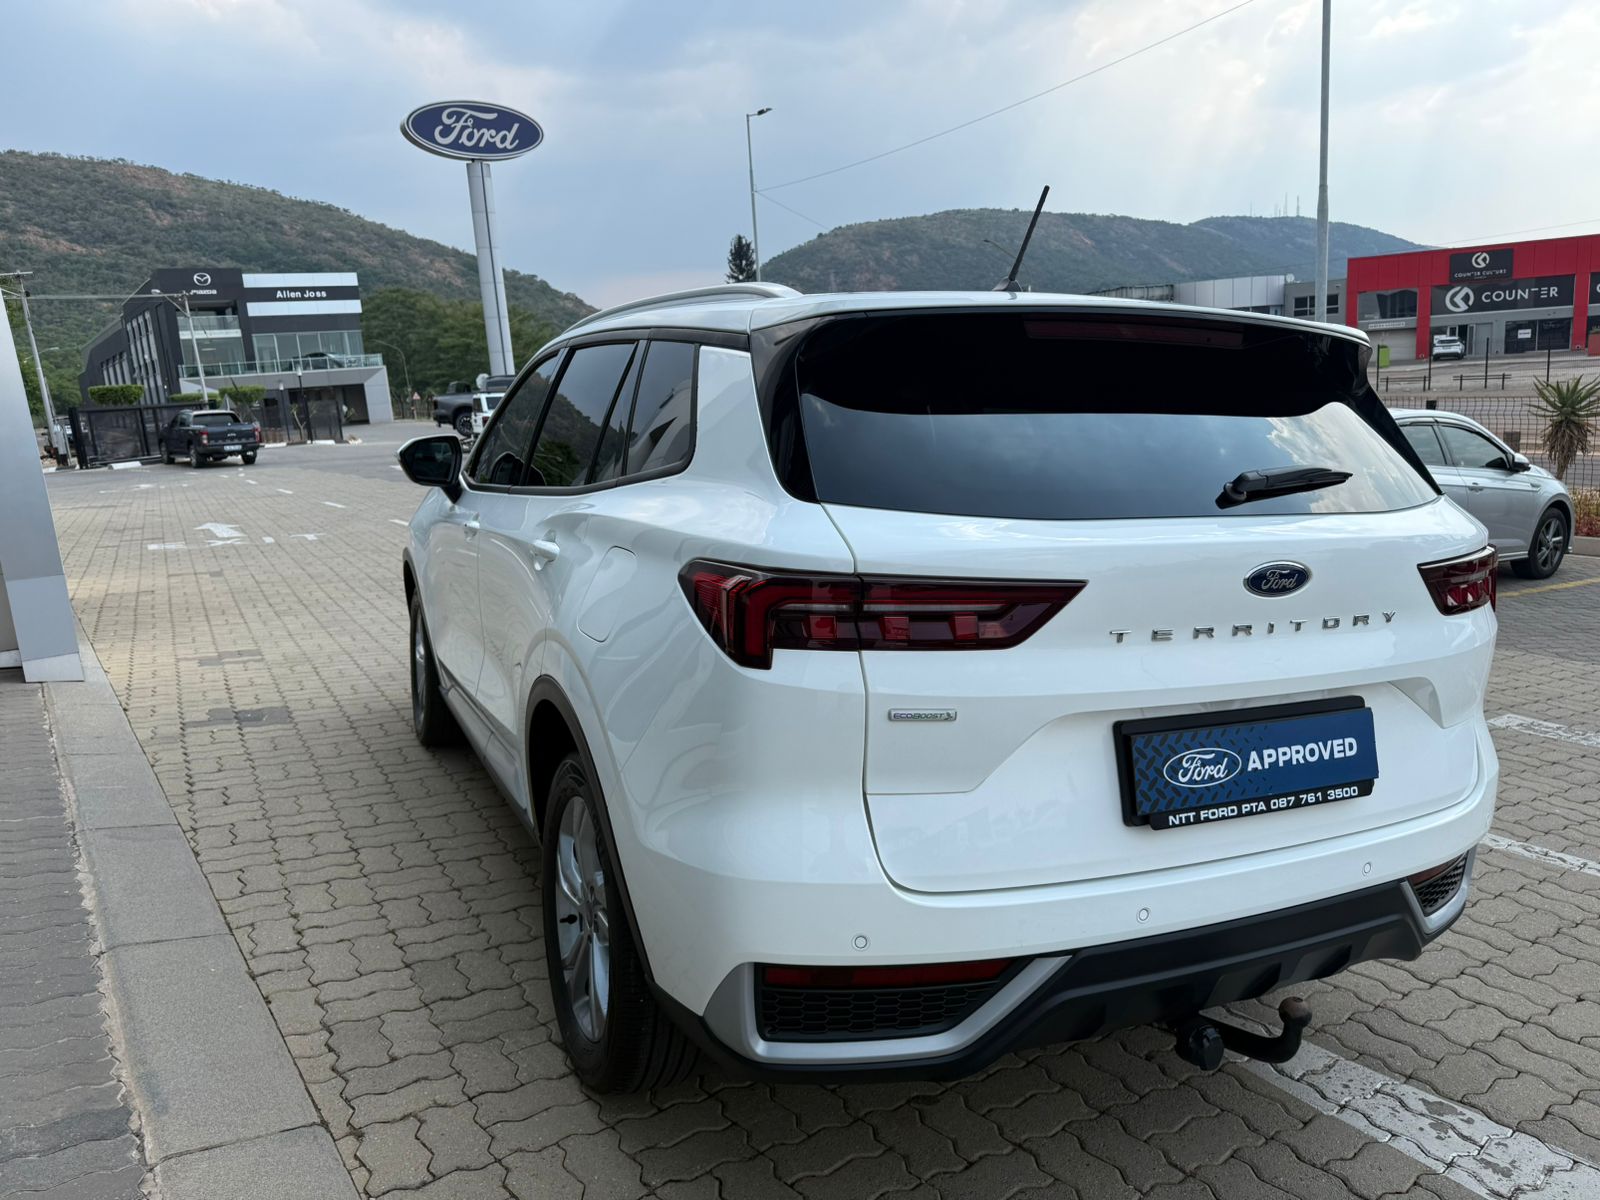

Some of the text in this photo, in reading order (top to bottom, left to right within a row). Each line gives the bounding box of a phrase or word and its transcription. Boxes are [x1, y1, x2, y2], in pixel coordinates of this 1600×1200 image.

[434, 107, 520, 150] Ford
[276, 289, 327, 298] Allen Joss
[1481, 286, 1559, 303] COUNTER
[1261, 569, 1297, 590] Ford
[1109, 610, 1396, 643] TERRITORY
[893, 712, 945, 720] ECOBOOST
[1178, 737, 1358, 783] Ford APPROVED
[1168, 786, 1359, 826] NTT FORD PTA 087 761 3500
